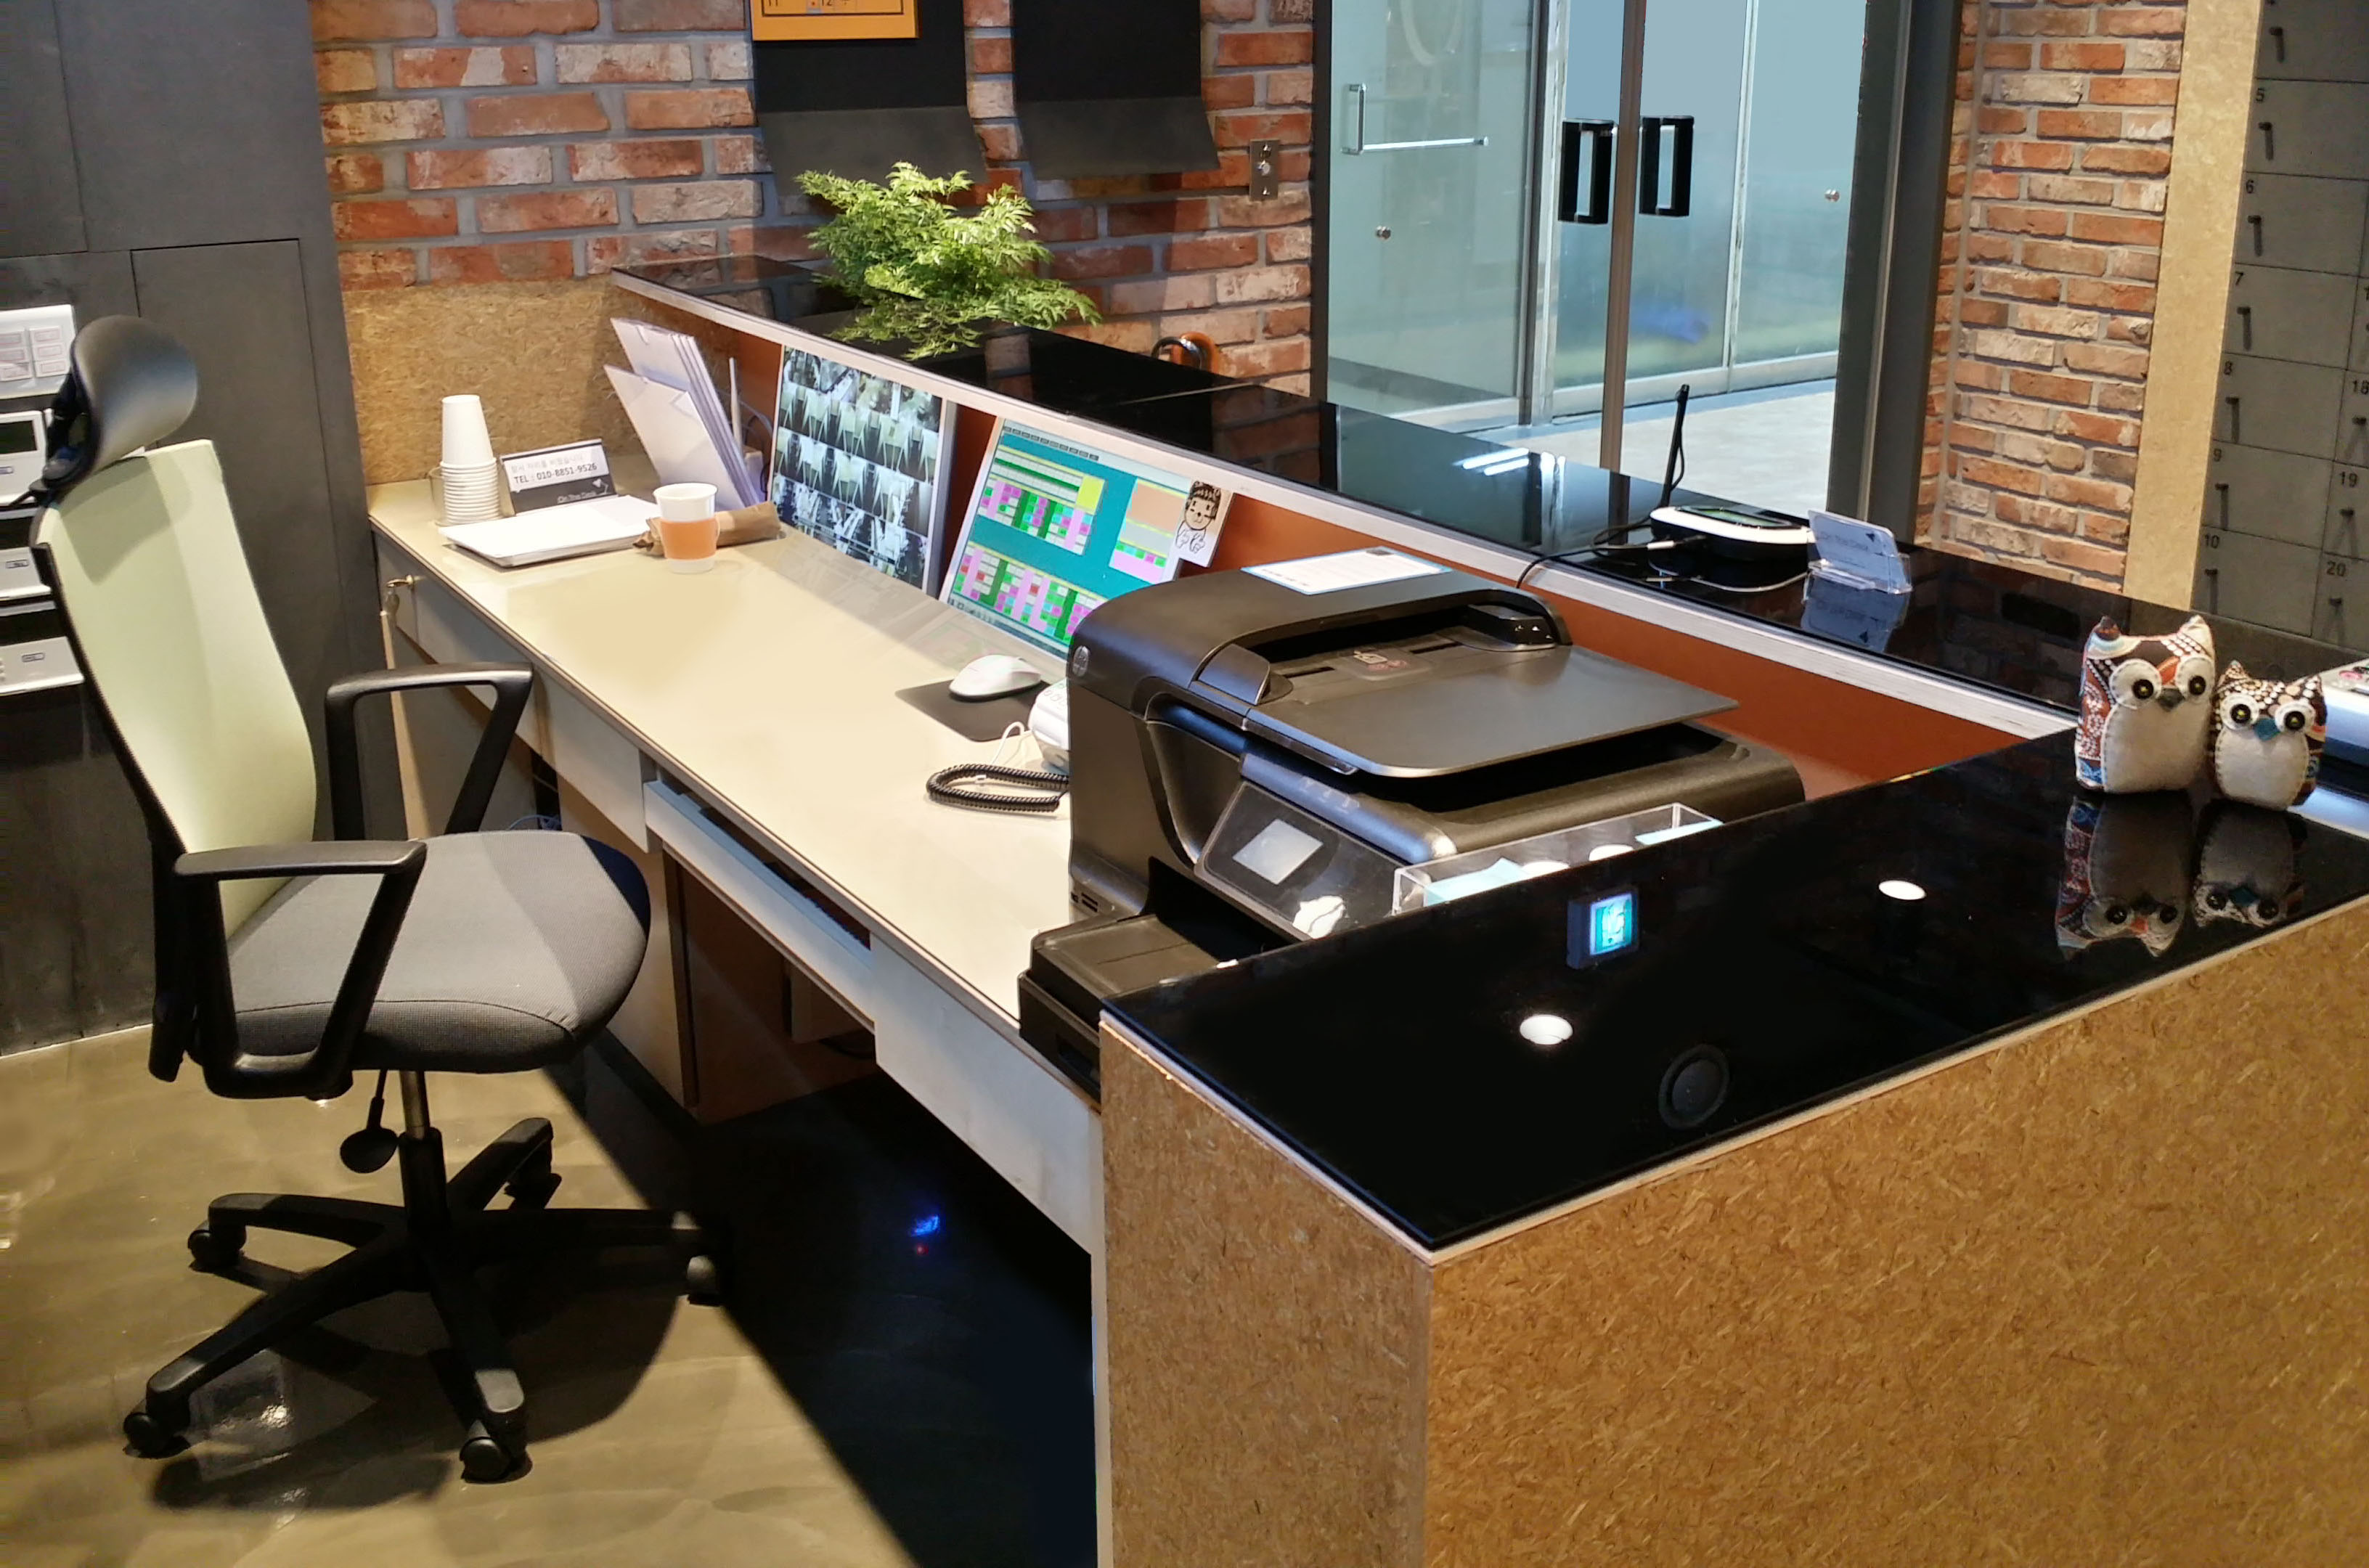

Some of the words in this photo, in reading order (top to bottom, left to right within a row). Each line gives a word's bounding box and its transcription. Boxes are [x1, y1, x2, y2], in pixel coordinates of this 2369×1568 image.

[2255, 88, 2265, 104] 5
[2246, 180, 2254, 194] 6
[2235, 271, 2243, 285] 7
[2224, 362, 2233, 376] 8
[2352, 379, 2369, 395] 18
[2213, 449, 2222, 462] 9
[513, 475, 529, 483] TEL
[536, 462, 598, 481] 010-8851-9526
[2339, 471, 2358, 488] 19
[2203, 534, 2219, 549] 10
[2326, 560, 2346, 578] 20
